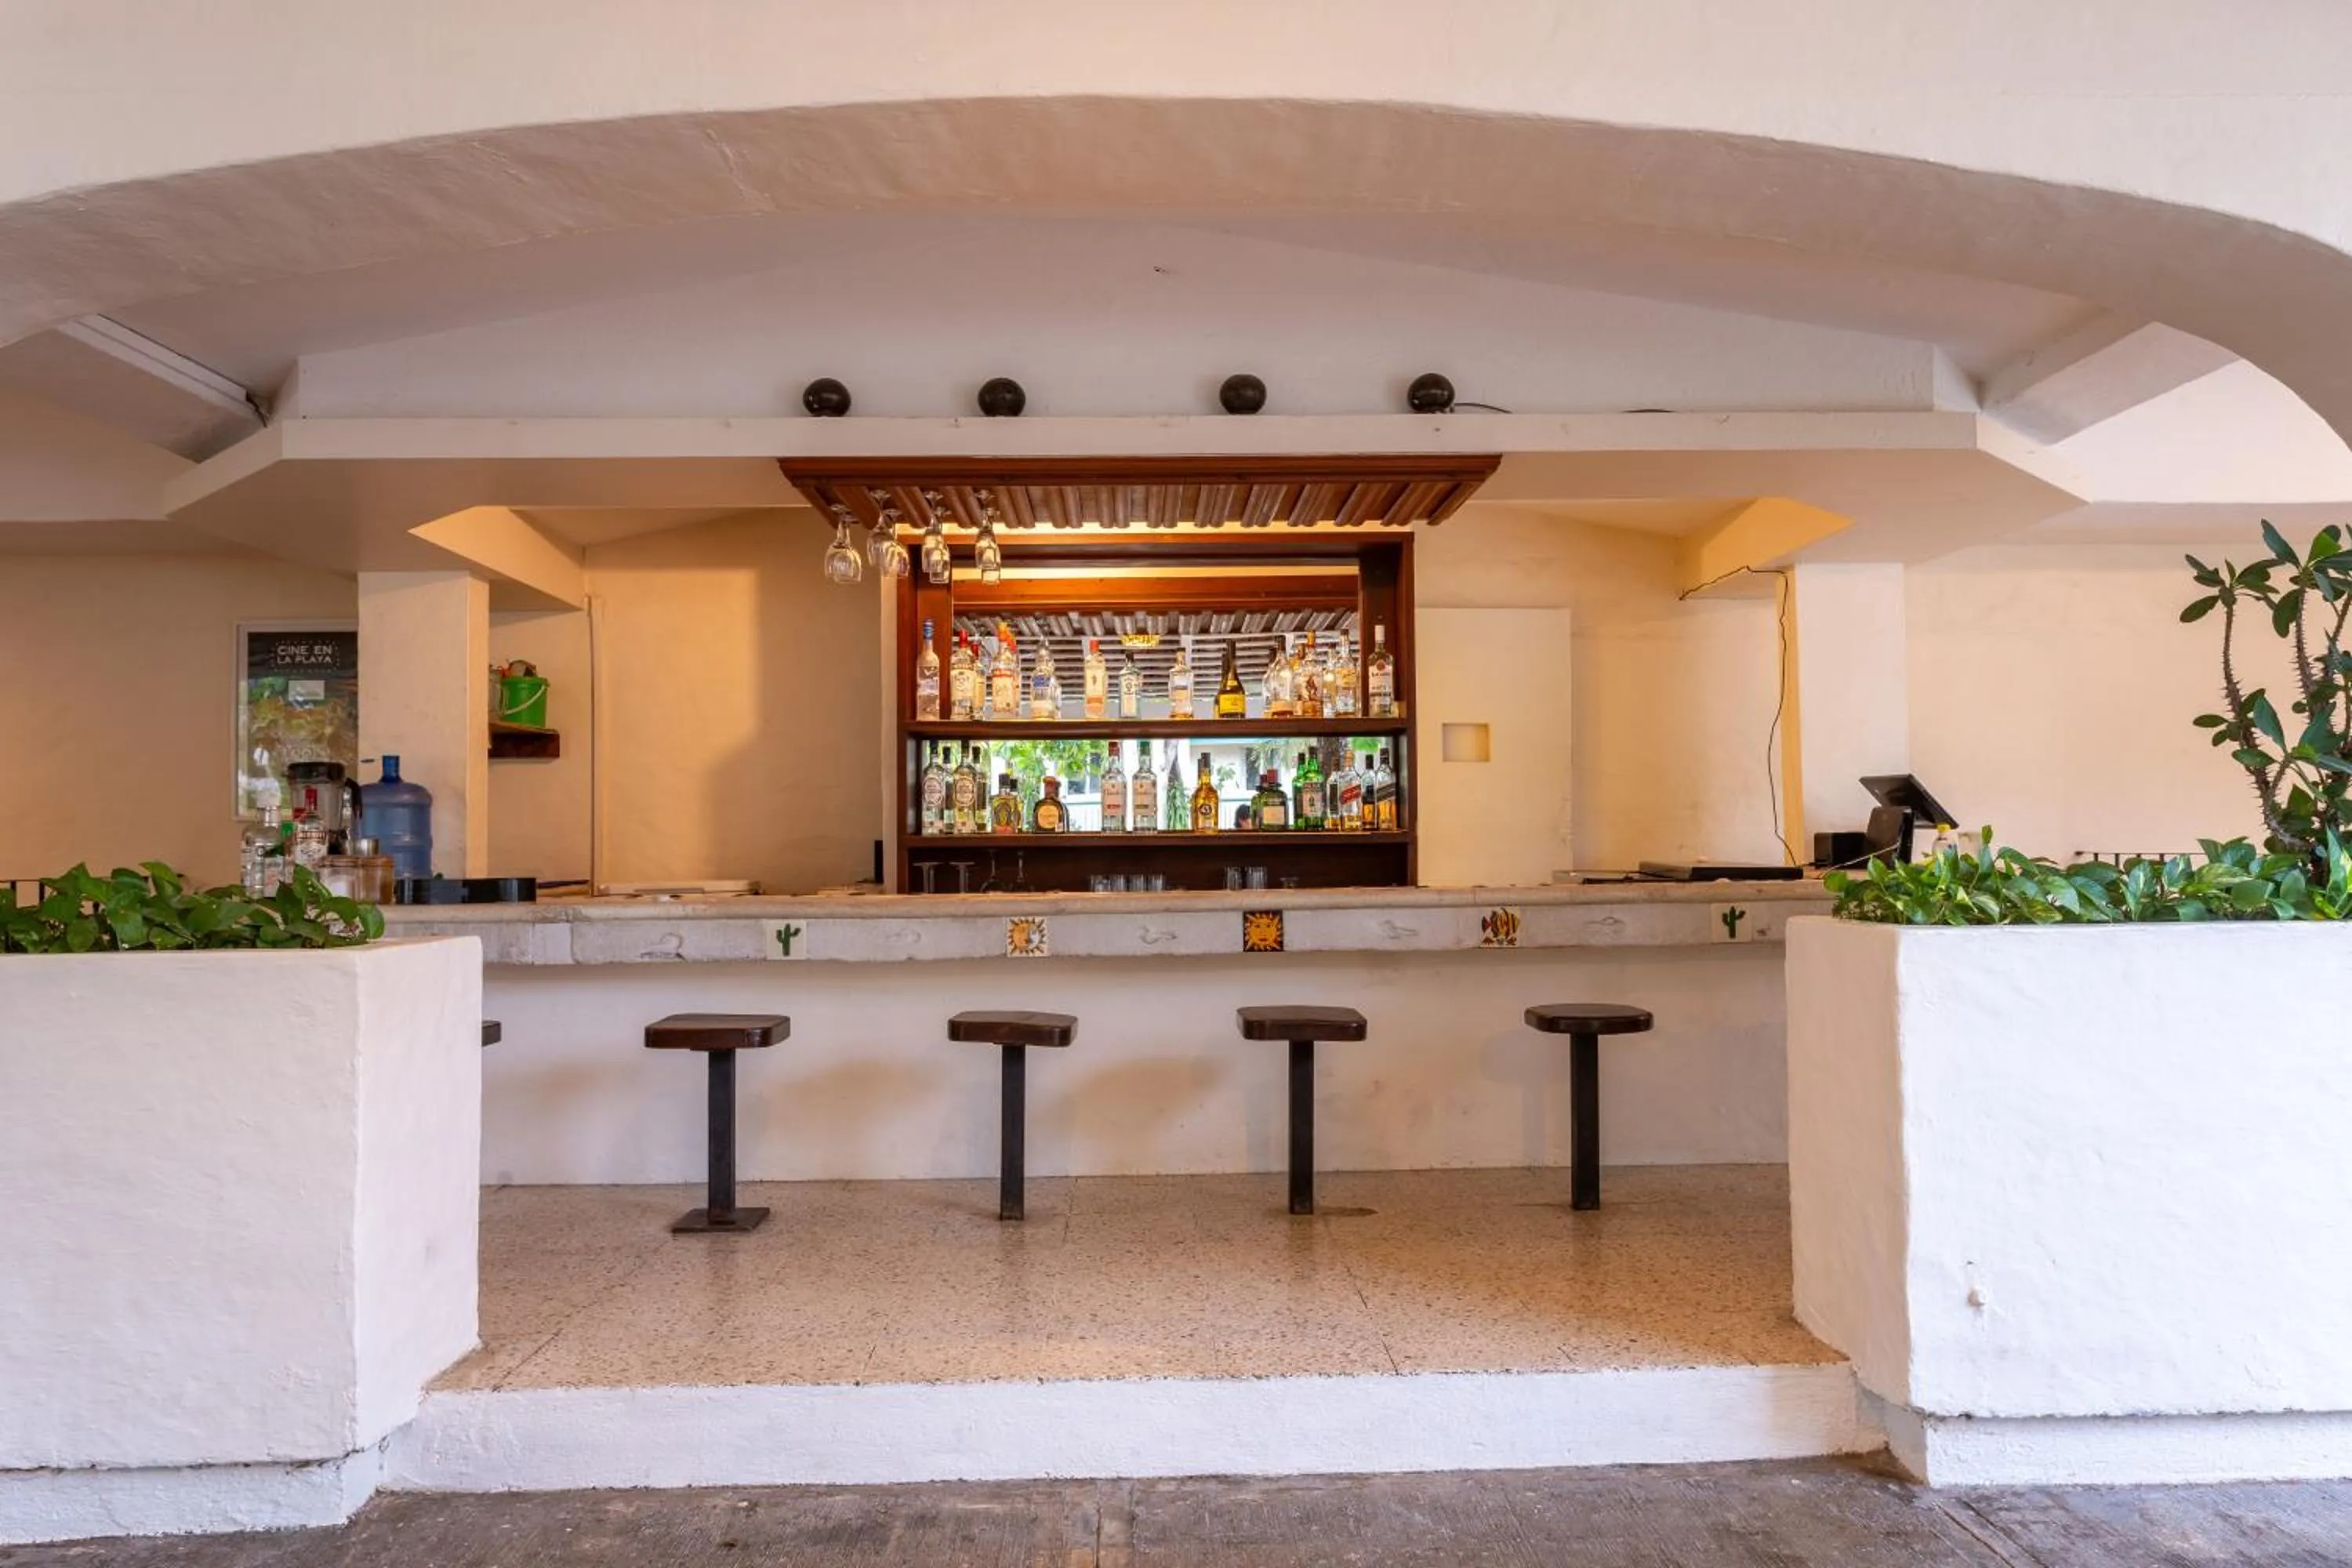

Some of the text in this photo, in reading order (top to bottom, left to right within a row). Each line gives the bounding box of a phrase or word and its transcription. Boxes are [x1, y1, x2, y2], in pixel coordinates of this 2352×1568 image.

[277, 644, 332, 655] CINE EN
[277, 655, 332, 664] LA PLAYA
